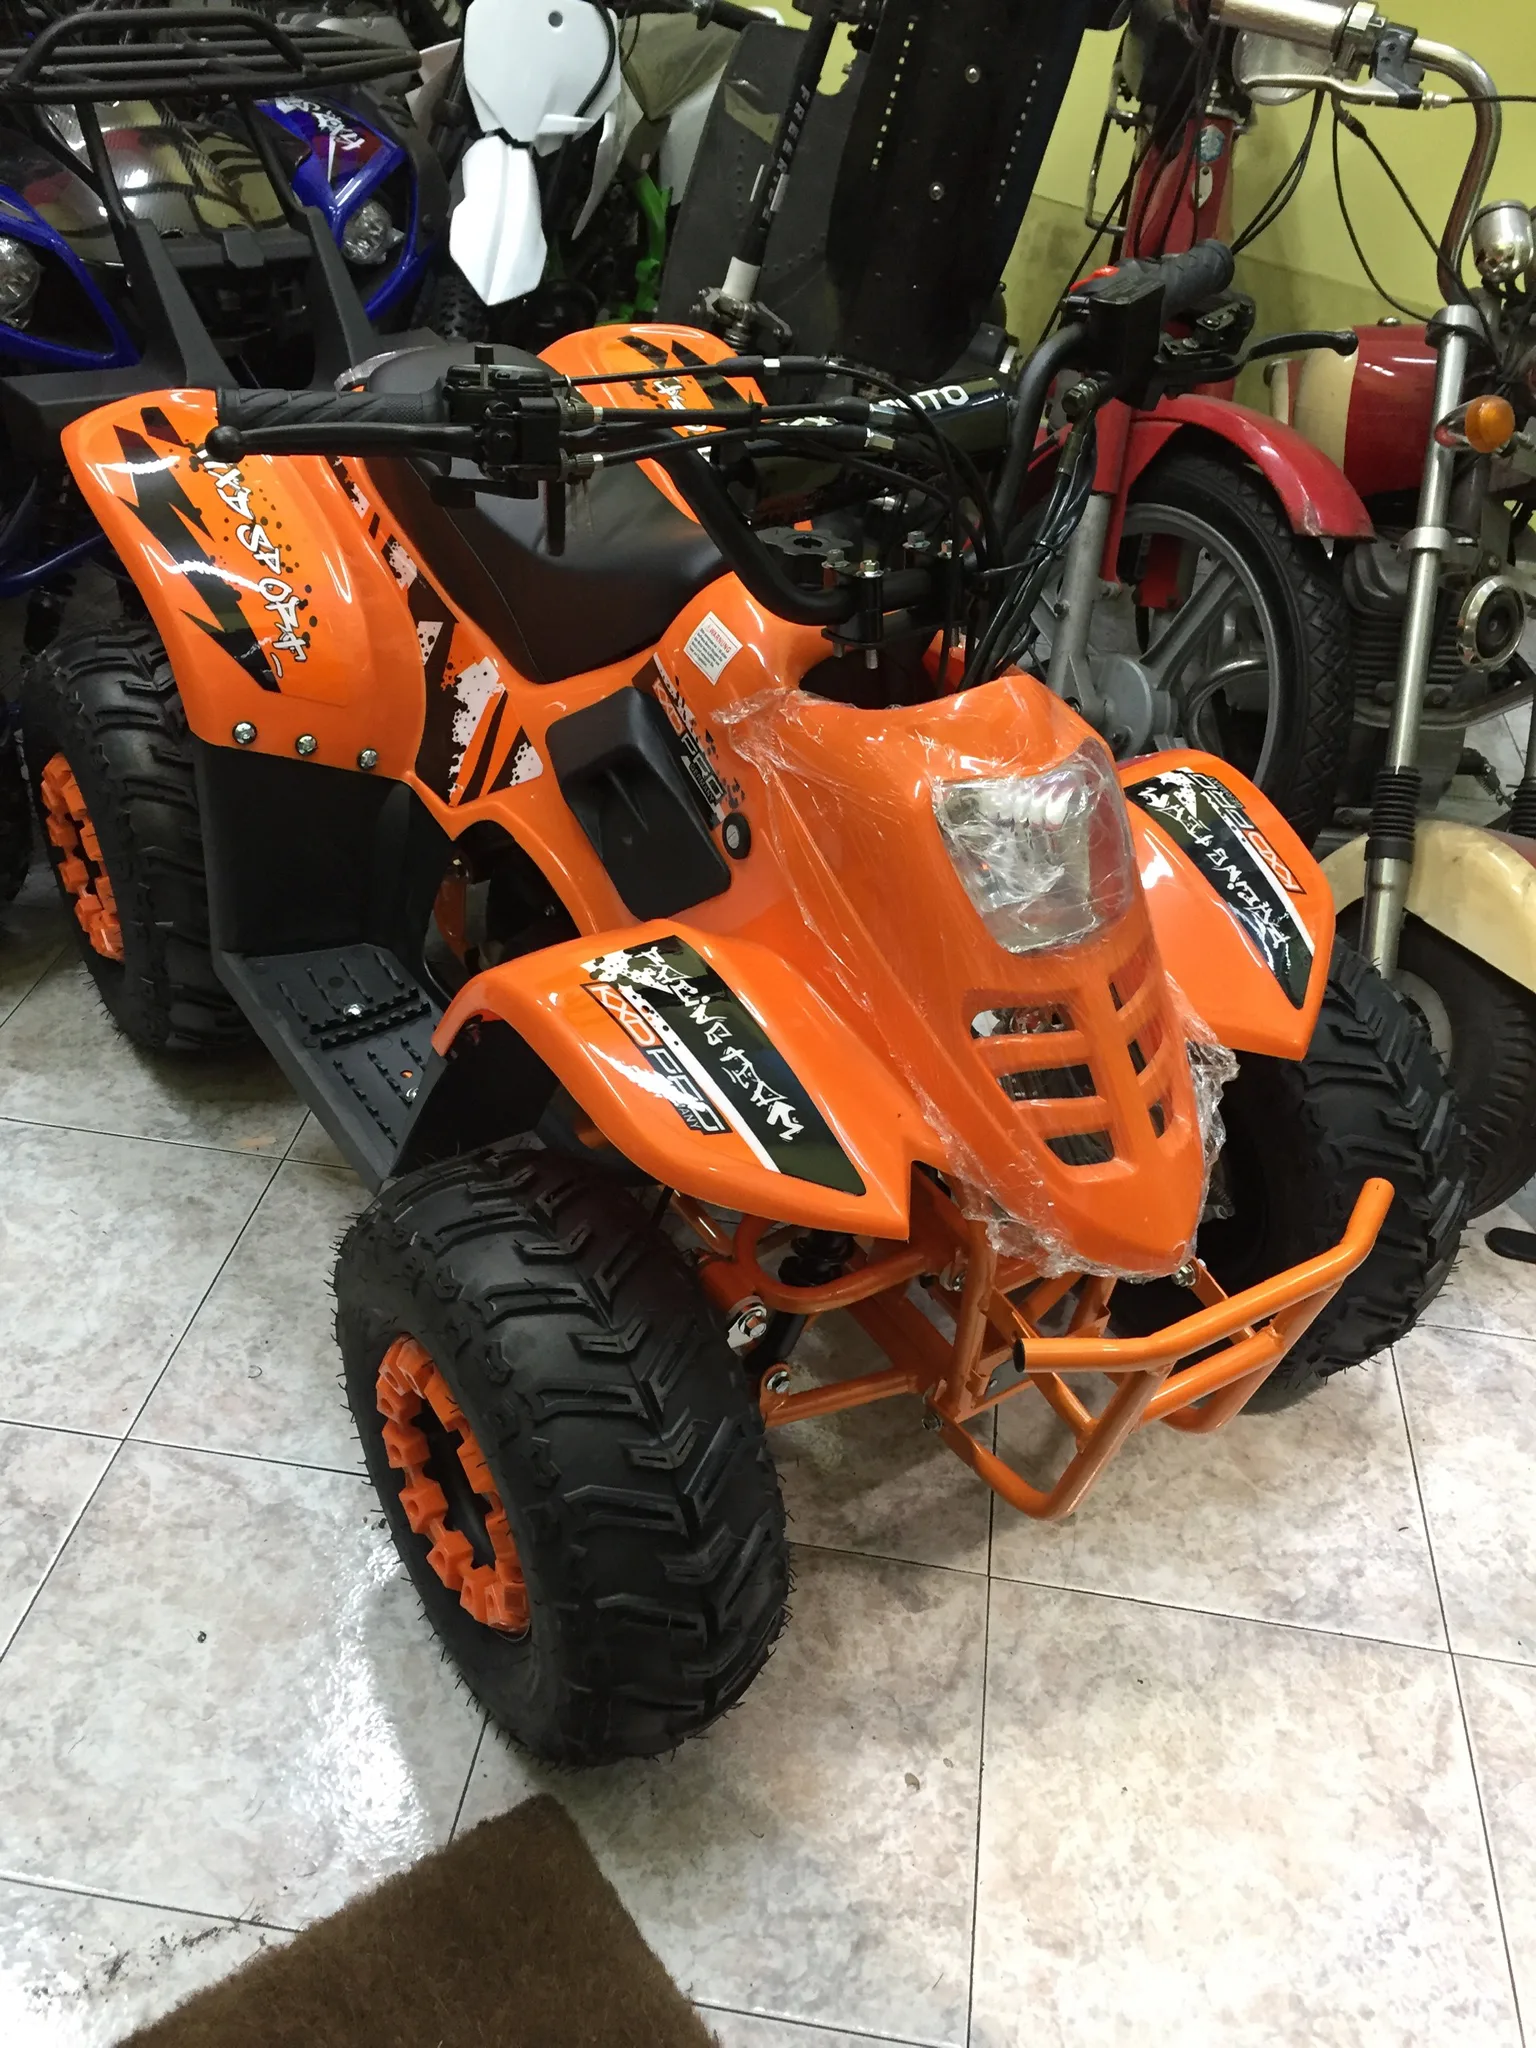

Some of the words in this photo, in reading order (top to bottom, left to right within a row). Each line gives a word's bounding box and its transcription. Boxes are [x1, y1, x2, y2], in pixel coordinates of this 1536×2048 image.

[236, 523, 307, 663] SPORT
[709, 627, 732, 654] WARNUNG
[653, 677, 682, 736] KXD
[681, 733, 724, 800] PRO
[690, 761, 716, 803] GERMANY
[1188, 772, 1255, 830] PRO
[1138, 786, 1214, 847] TEAM
[1248, 830, 1303, 892] KXD
[1206, 847, 1291, 949] RACING
[591, 985, 656, 1046] KXD
[633, 946, 733, 1046] RACING
[719, 1045, 805, 1142] TEAM
